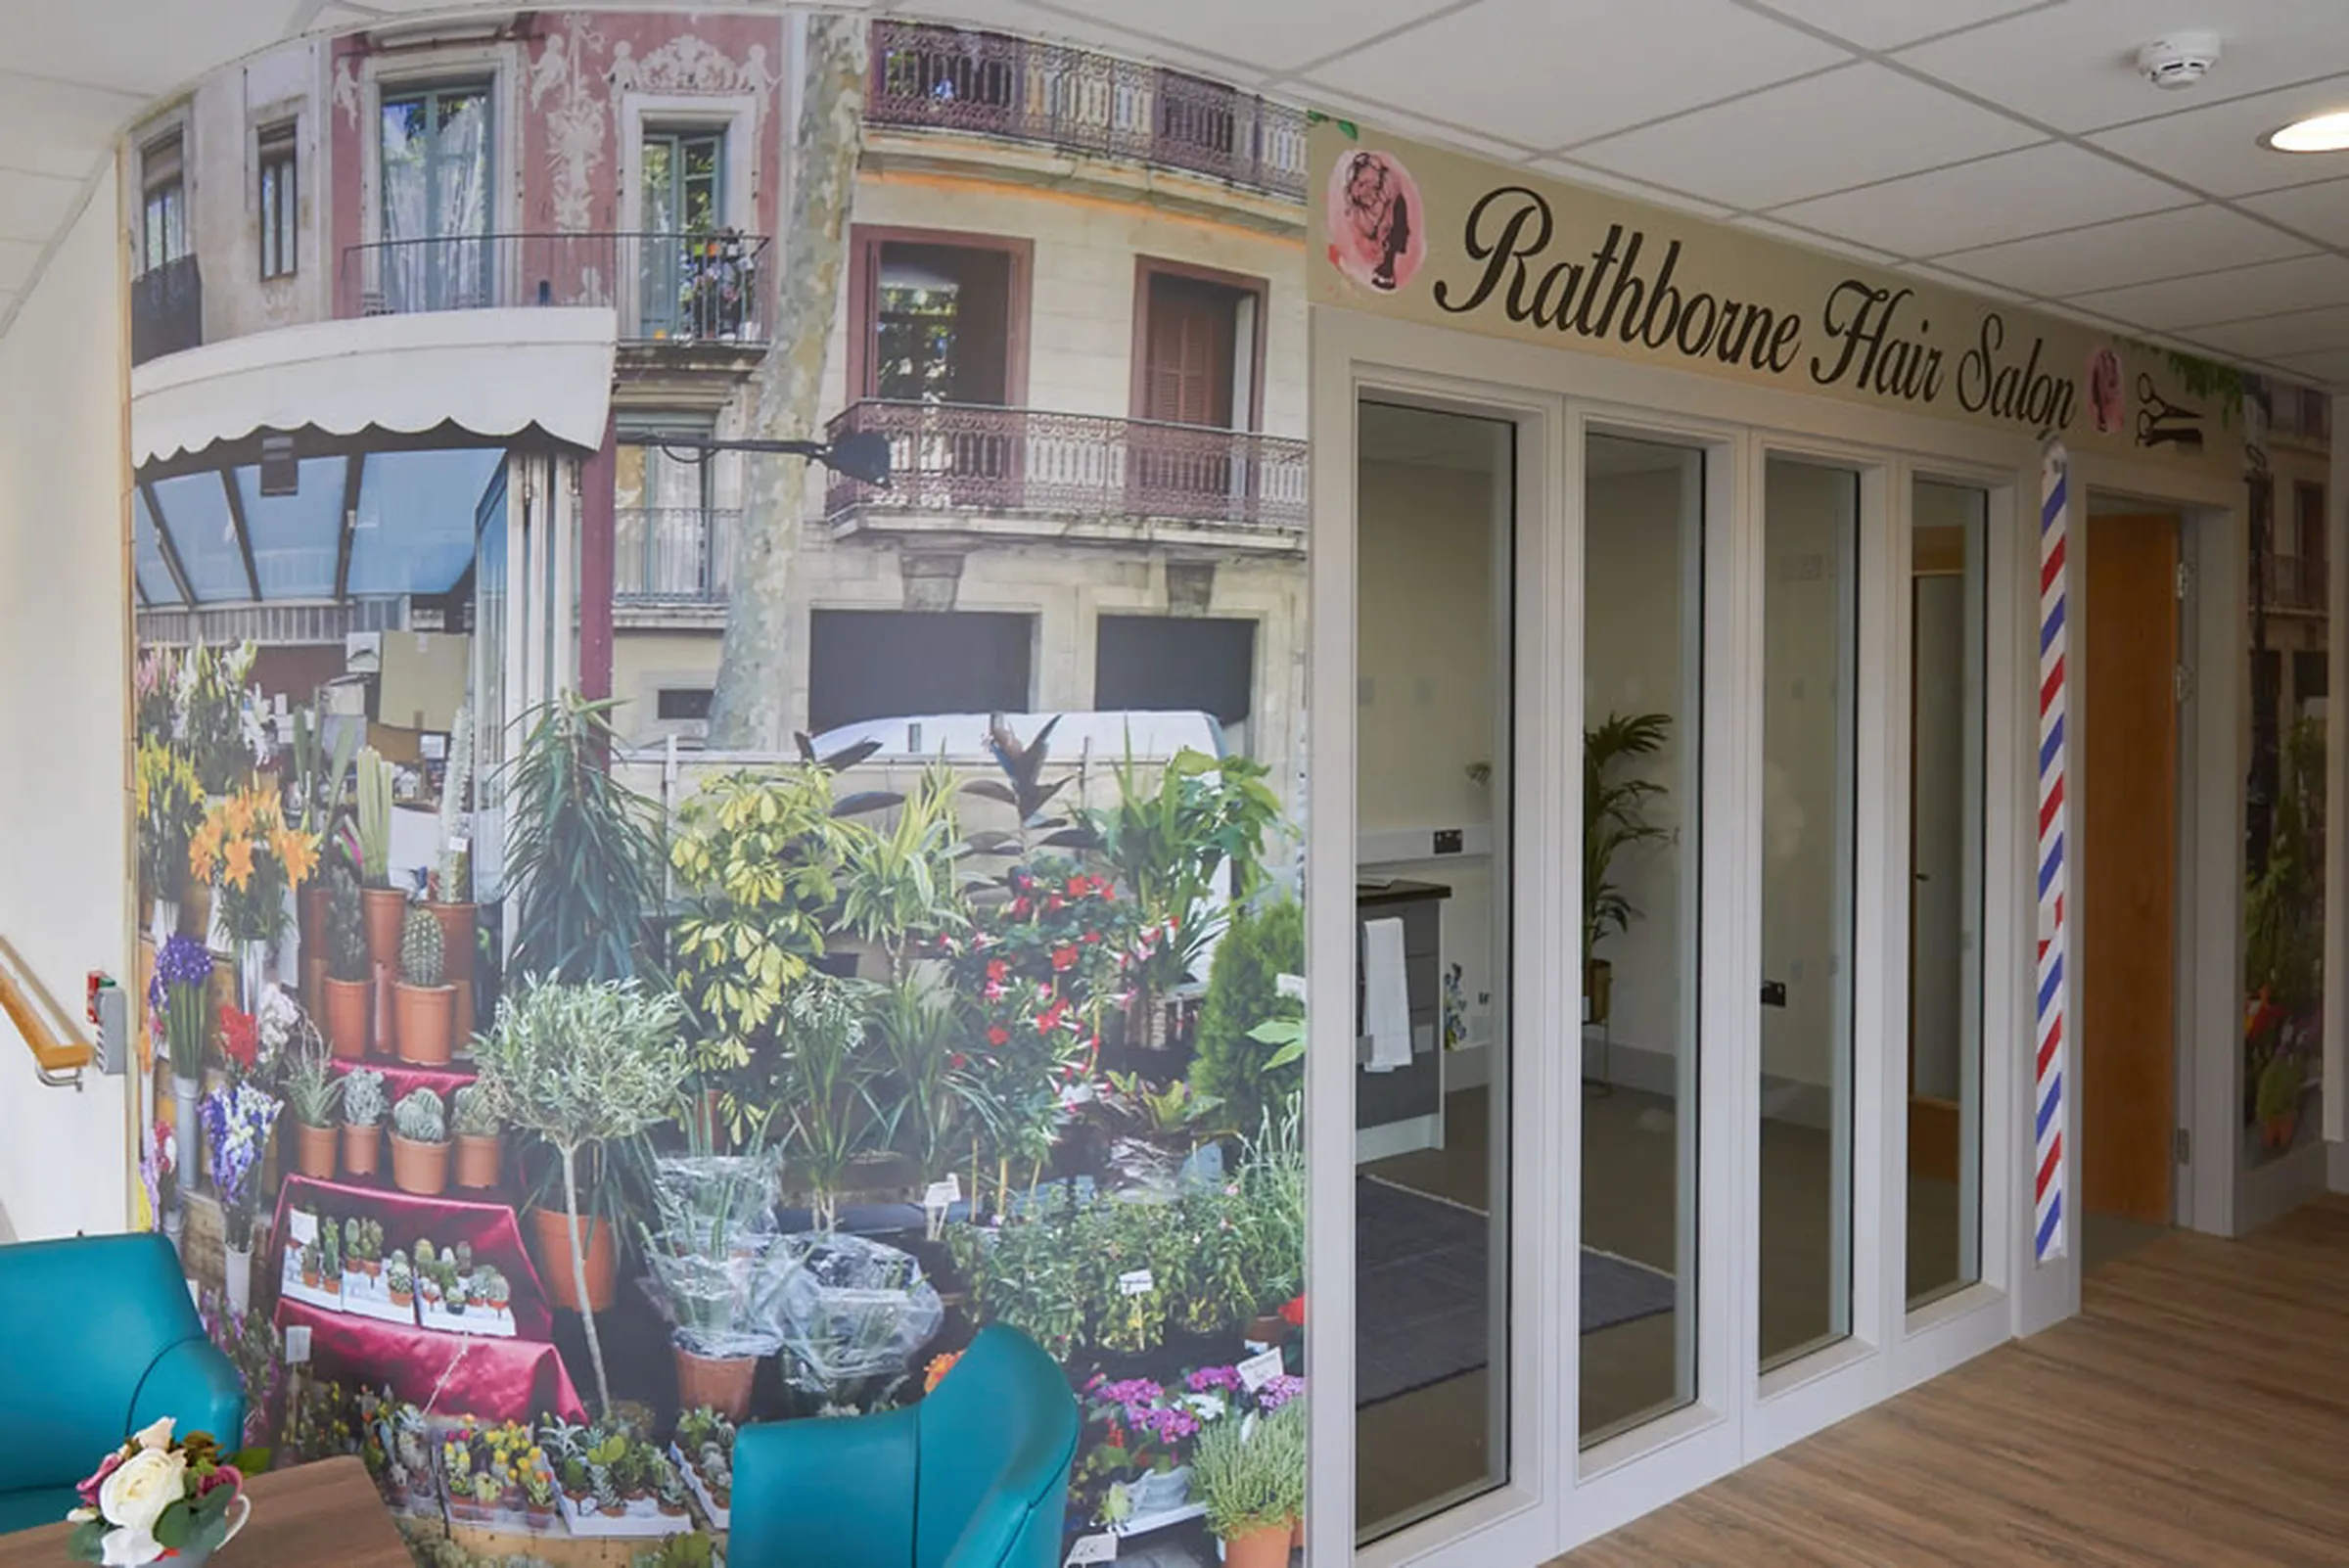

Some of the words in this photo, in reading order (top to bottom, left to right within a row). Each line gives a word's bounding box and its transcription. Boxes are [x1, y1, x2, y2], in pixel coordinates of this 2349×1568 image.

[1434, 186, 1801, 373] Rathborne
[1811, 279, 1944, 402] Hair
[1958, 313, 2076, 430] Salon
